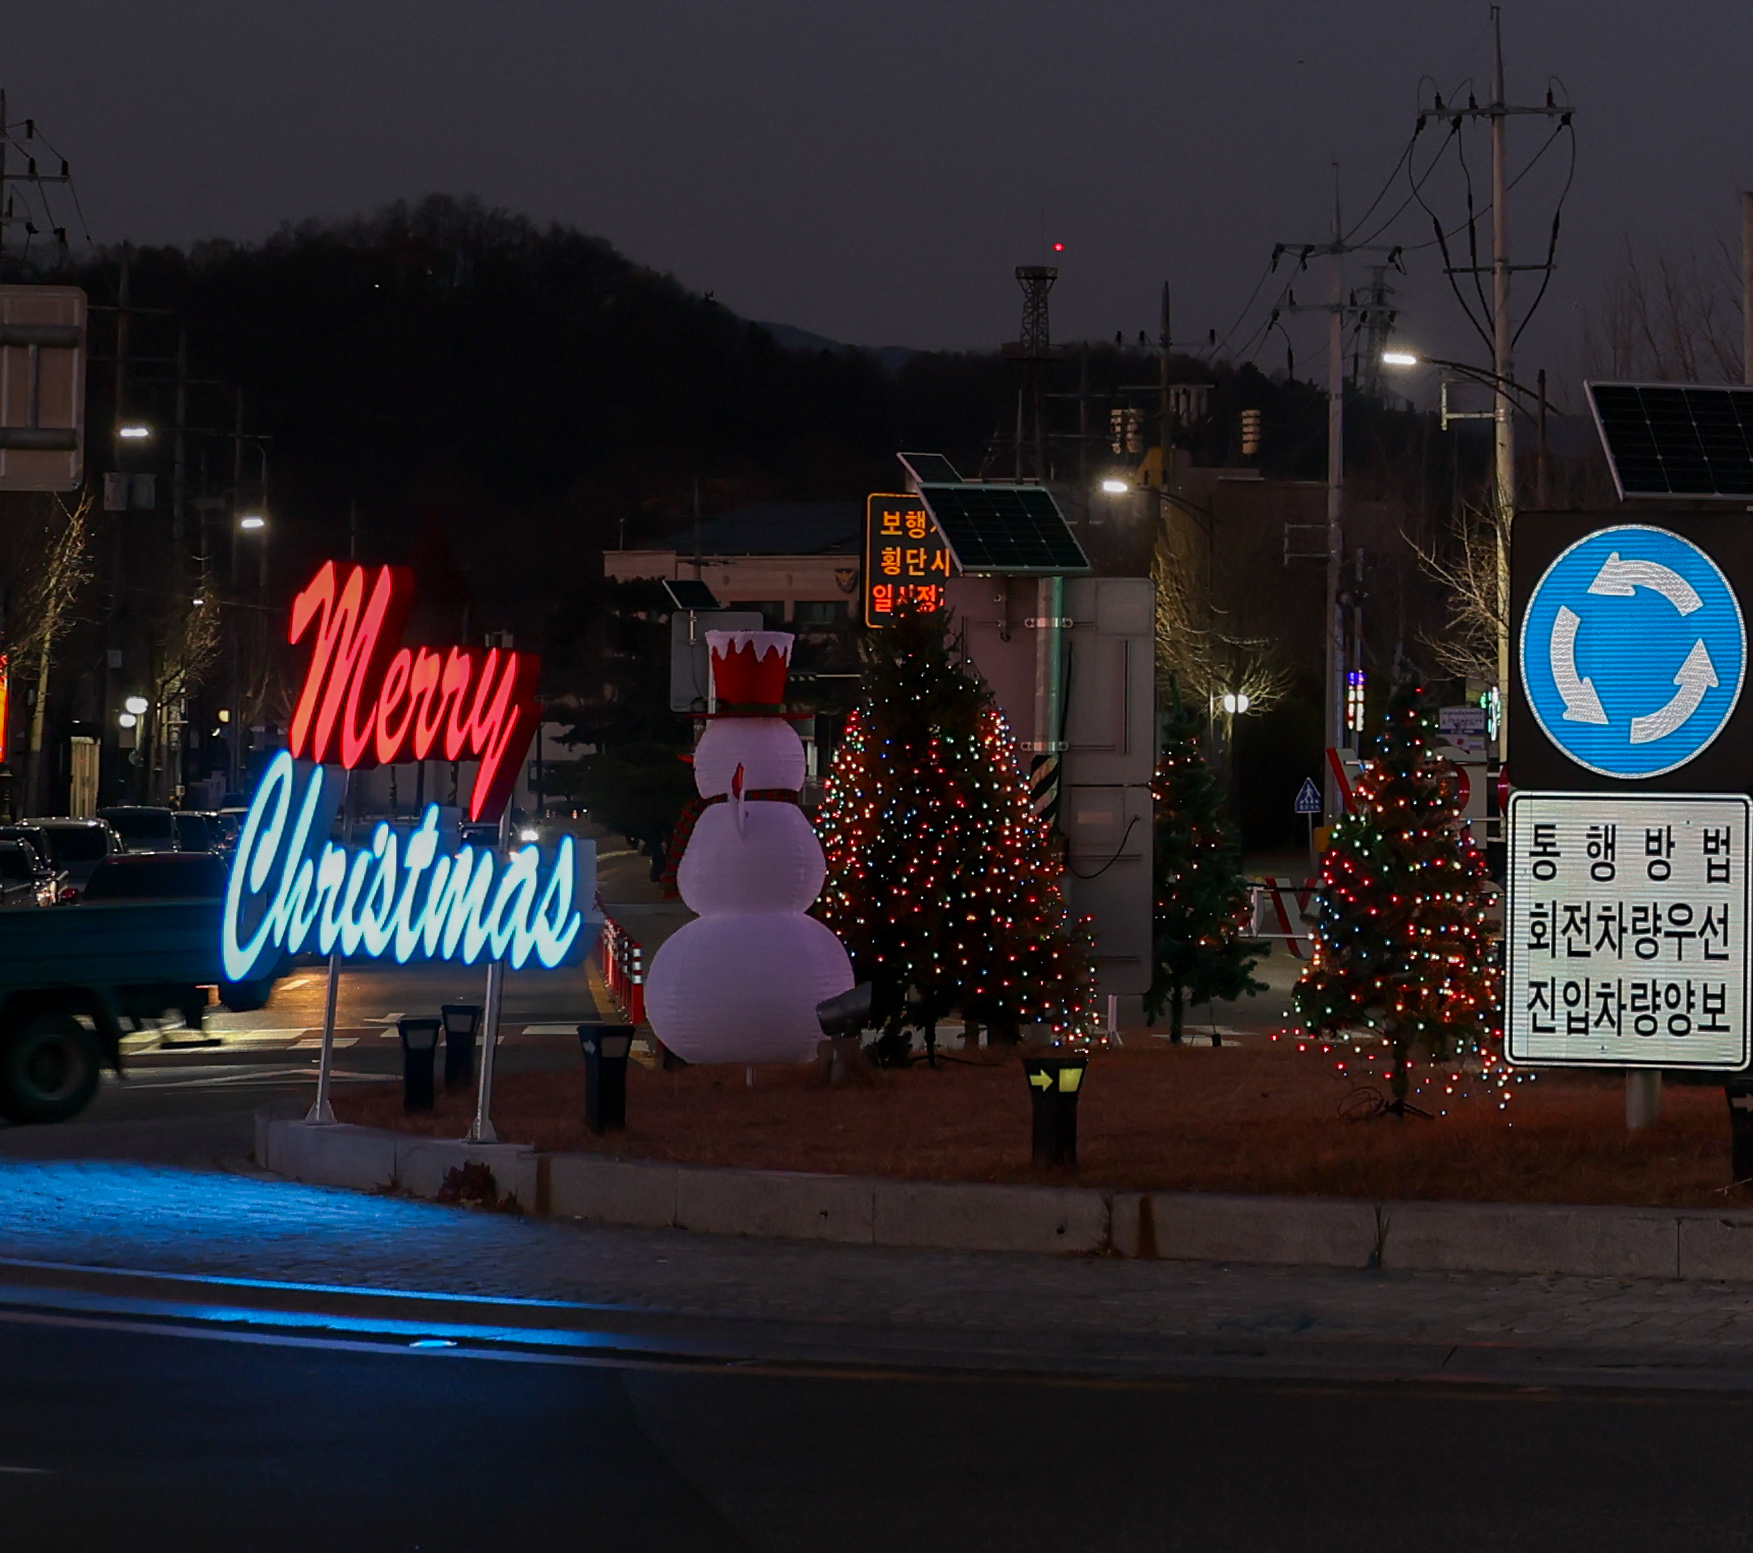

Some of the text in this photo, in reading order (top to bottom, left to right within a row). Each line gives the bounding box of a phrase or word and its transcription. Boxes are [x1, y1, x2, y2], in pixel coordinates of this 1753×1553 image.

[880, 510, 938, 539] 보행
[288, 559, 520, 823] Merry
[221, 748, 584, 983] Christmas
[1528, 899, 1731, 963] 회전차량우선
[1526, 976, 1732, 1038] 진입차량양보
